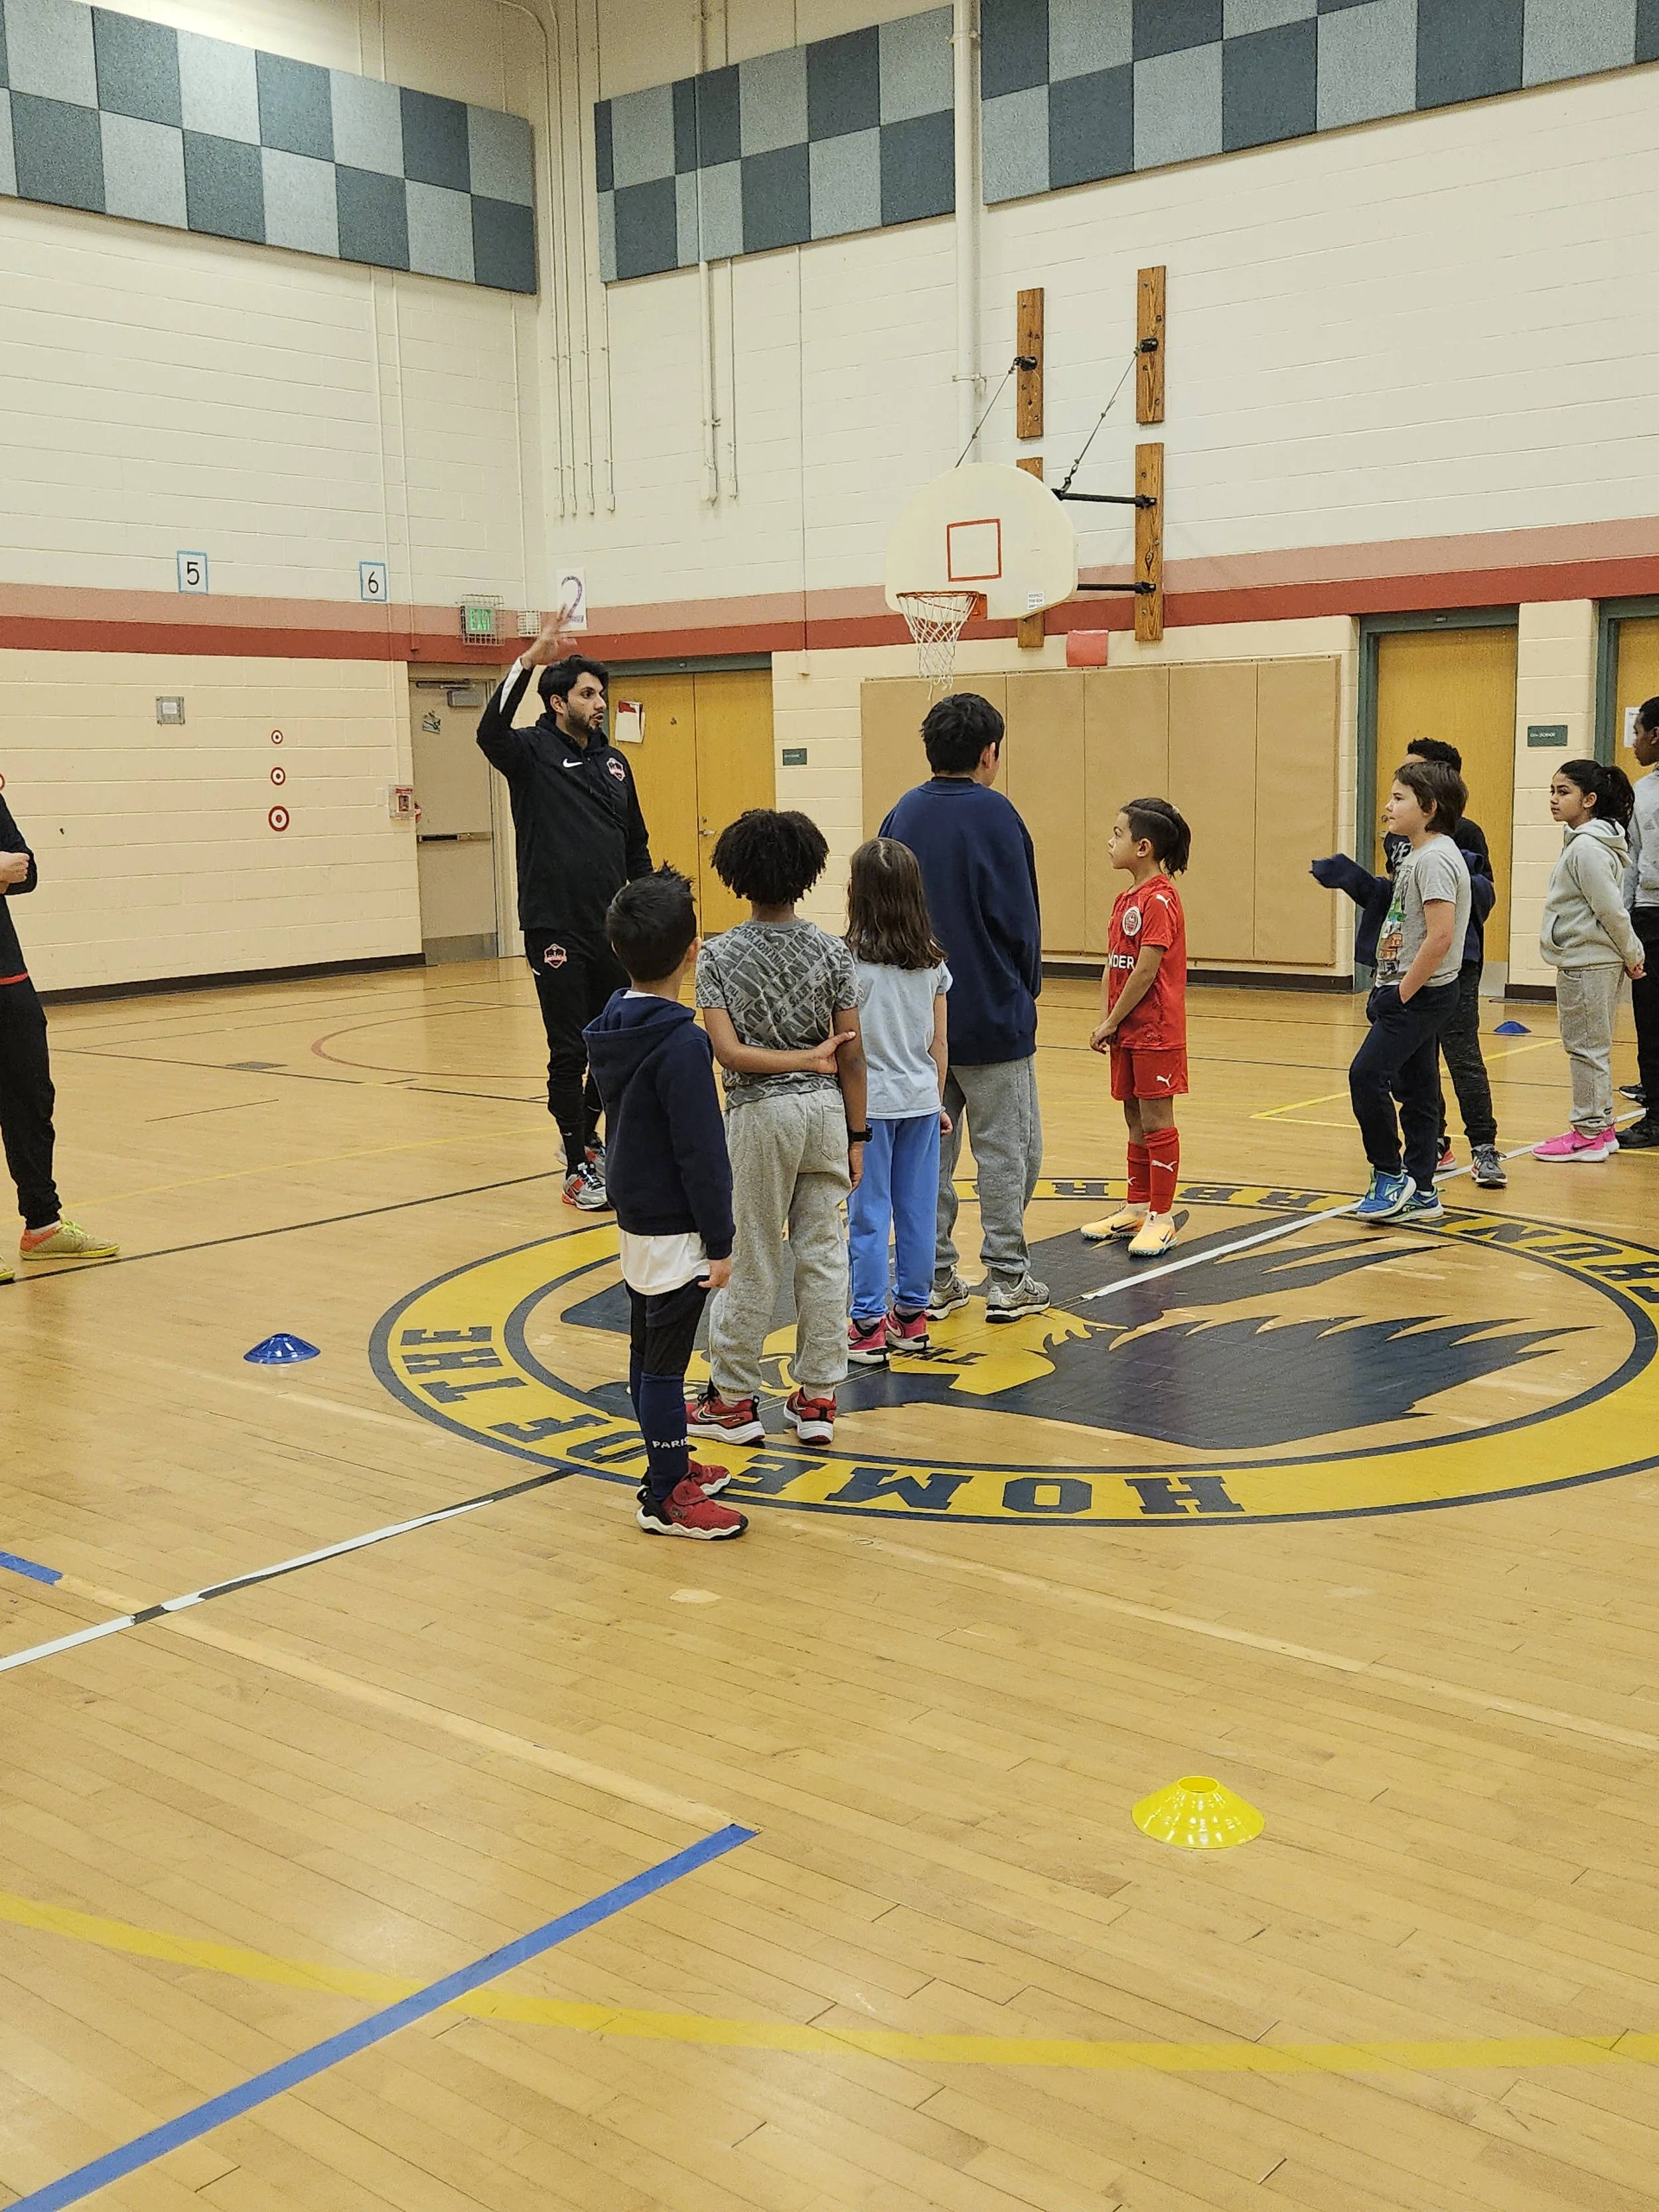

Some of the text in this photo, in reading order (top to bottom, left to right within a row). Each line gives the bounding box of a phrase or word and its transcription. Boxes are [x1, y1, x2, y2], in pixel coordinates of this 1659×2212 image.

[186, 561, 200, 585] 5
[368, 571, 380, 594] 6
[560, 575, 585, 623] 2
[470, 609, 491, 631] EXIT
[400, 1325, 528, 1404] THE
[487, 1414, 653, 1465] OF
[652, 1436, 689, 1449] PARIS
[730, 1452, 1246, 1516] HOME
